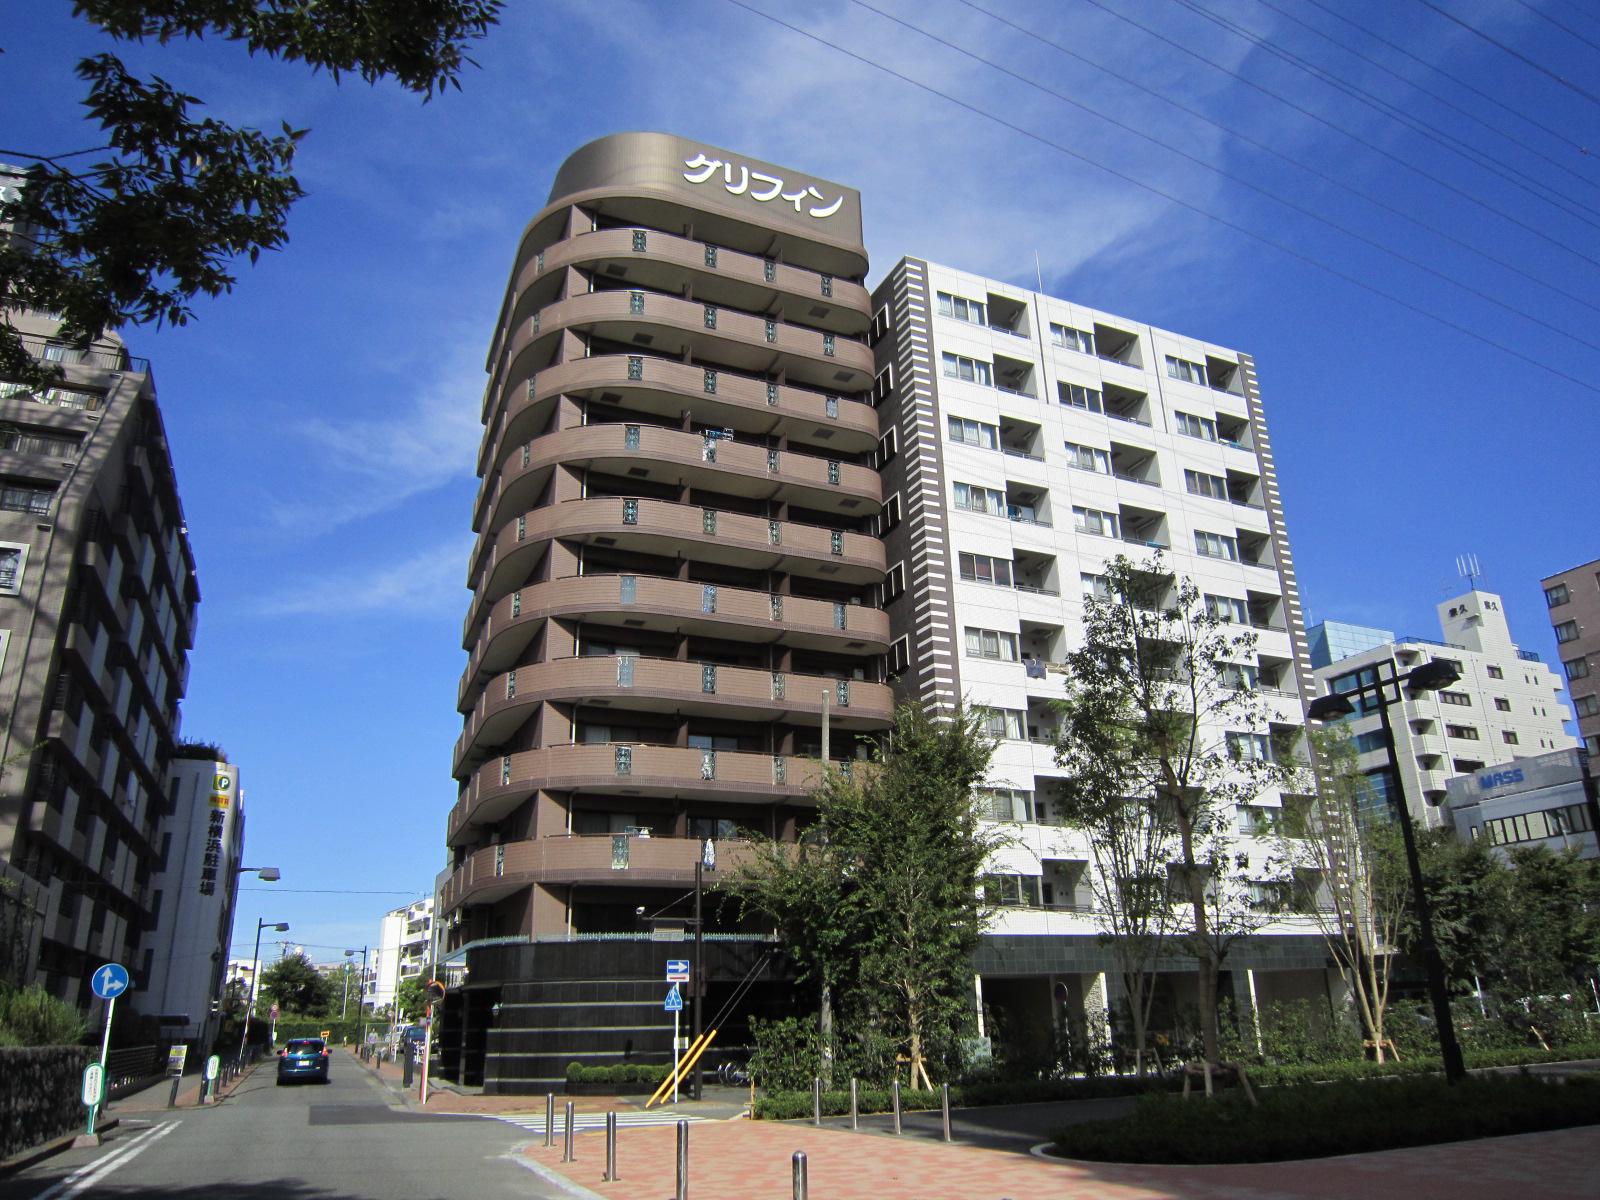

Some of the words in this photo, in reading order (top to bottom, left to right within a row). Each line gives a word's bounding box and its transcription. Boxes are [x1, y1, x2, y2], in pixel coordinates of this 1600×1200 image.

[683, 153, 843, 218] グリフィン
[1479, 768, 1525, 789] MASS
[199, 809, 226, 896] 新横浜駐車場
